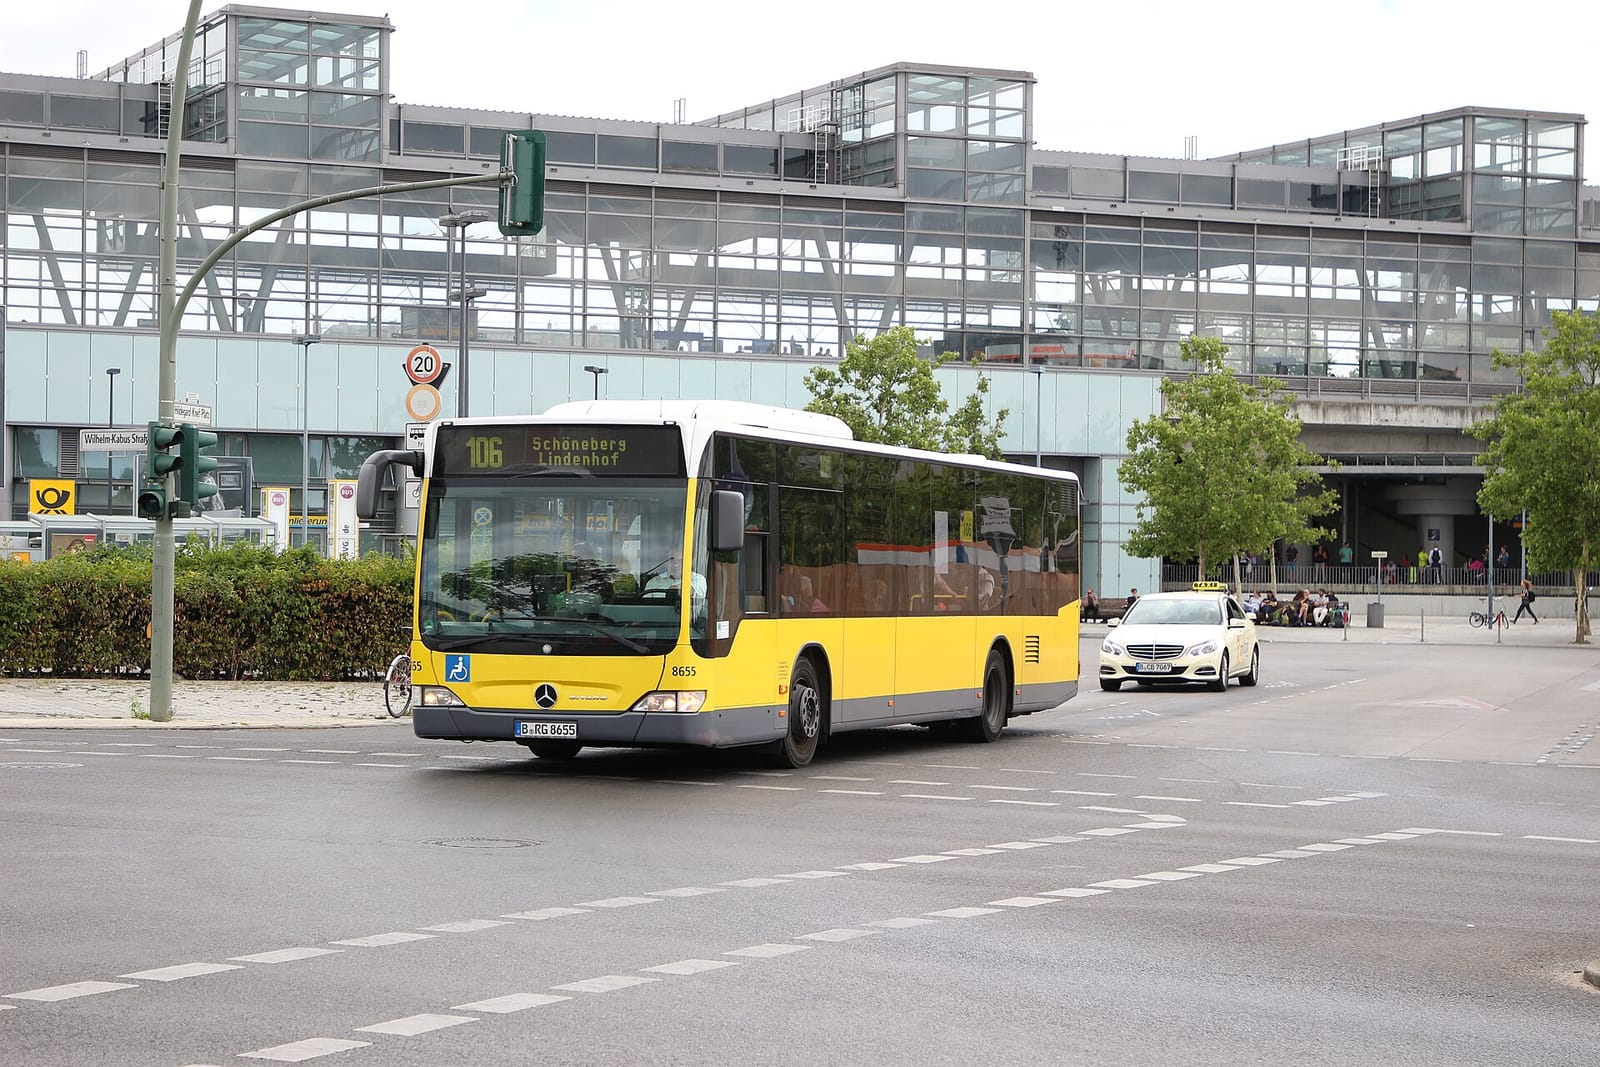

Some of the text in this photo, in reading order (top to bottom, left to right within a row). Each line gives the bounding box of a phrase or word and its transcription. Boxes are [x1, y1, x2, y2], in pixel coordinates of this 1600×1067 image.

[414, 356, 433, 372] 20
[131, 433, 148, 446] Straß
[532, 436, 626, 451] Schöneberg
[466, 437, 502, 468] 106
[538, 452, 619, 466] Lindenhof
[289, 517, 327, 526] nlieerun
[671, 666, 696, 677] 8655
[521, 723, 576, 736] B RG 8655
